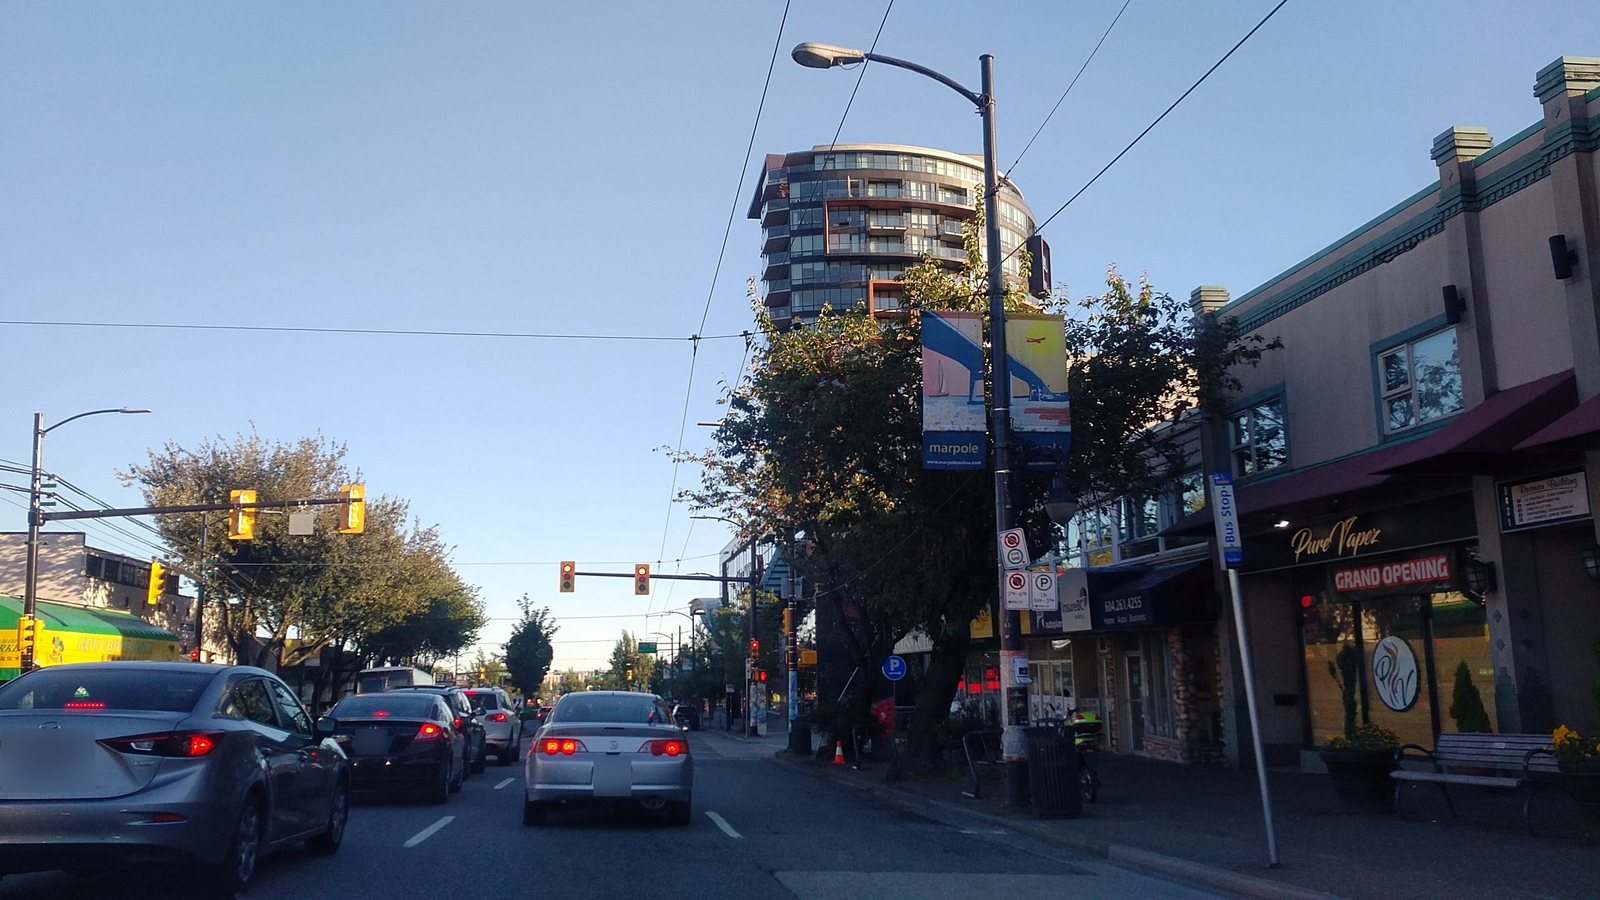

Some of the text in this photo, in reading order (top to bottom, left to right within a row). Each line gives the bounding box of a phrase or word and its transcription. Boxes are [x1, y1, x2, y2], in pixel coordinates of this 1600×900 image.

[929, 442, 979, 456] marpole
[1220, 489, 1232, 517] Stop
[1225, 521, 1235, 543] Bus
[1291, 516, 1381, 563] Pure Vapez
[1040, 577, 1049, 587] P
[1335, 557, 1449, 590] GRAND OPENING
[1104, 595, 1142, 613] 604.261.4255
[890, 659, 900, 671] P
